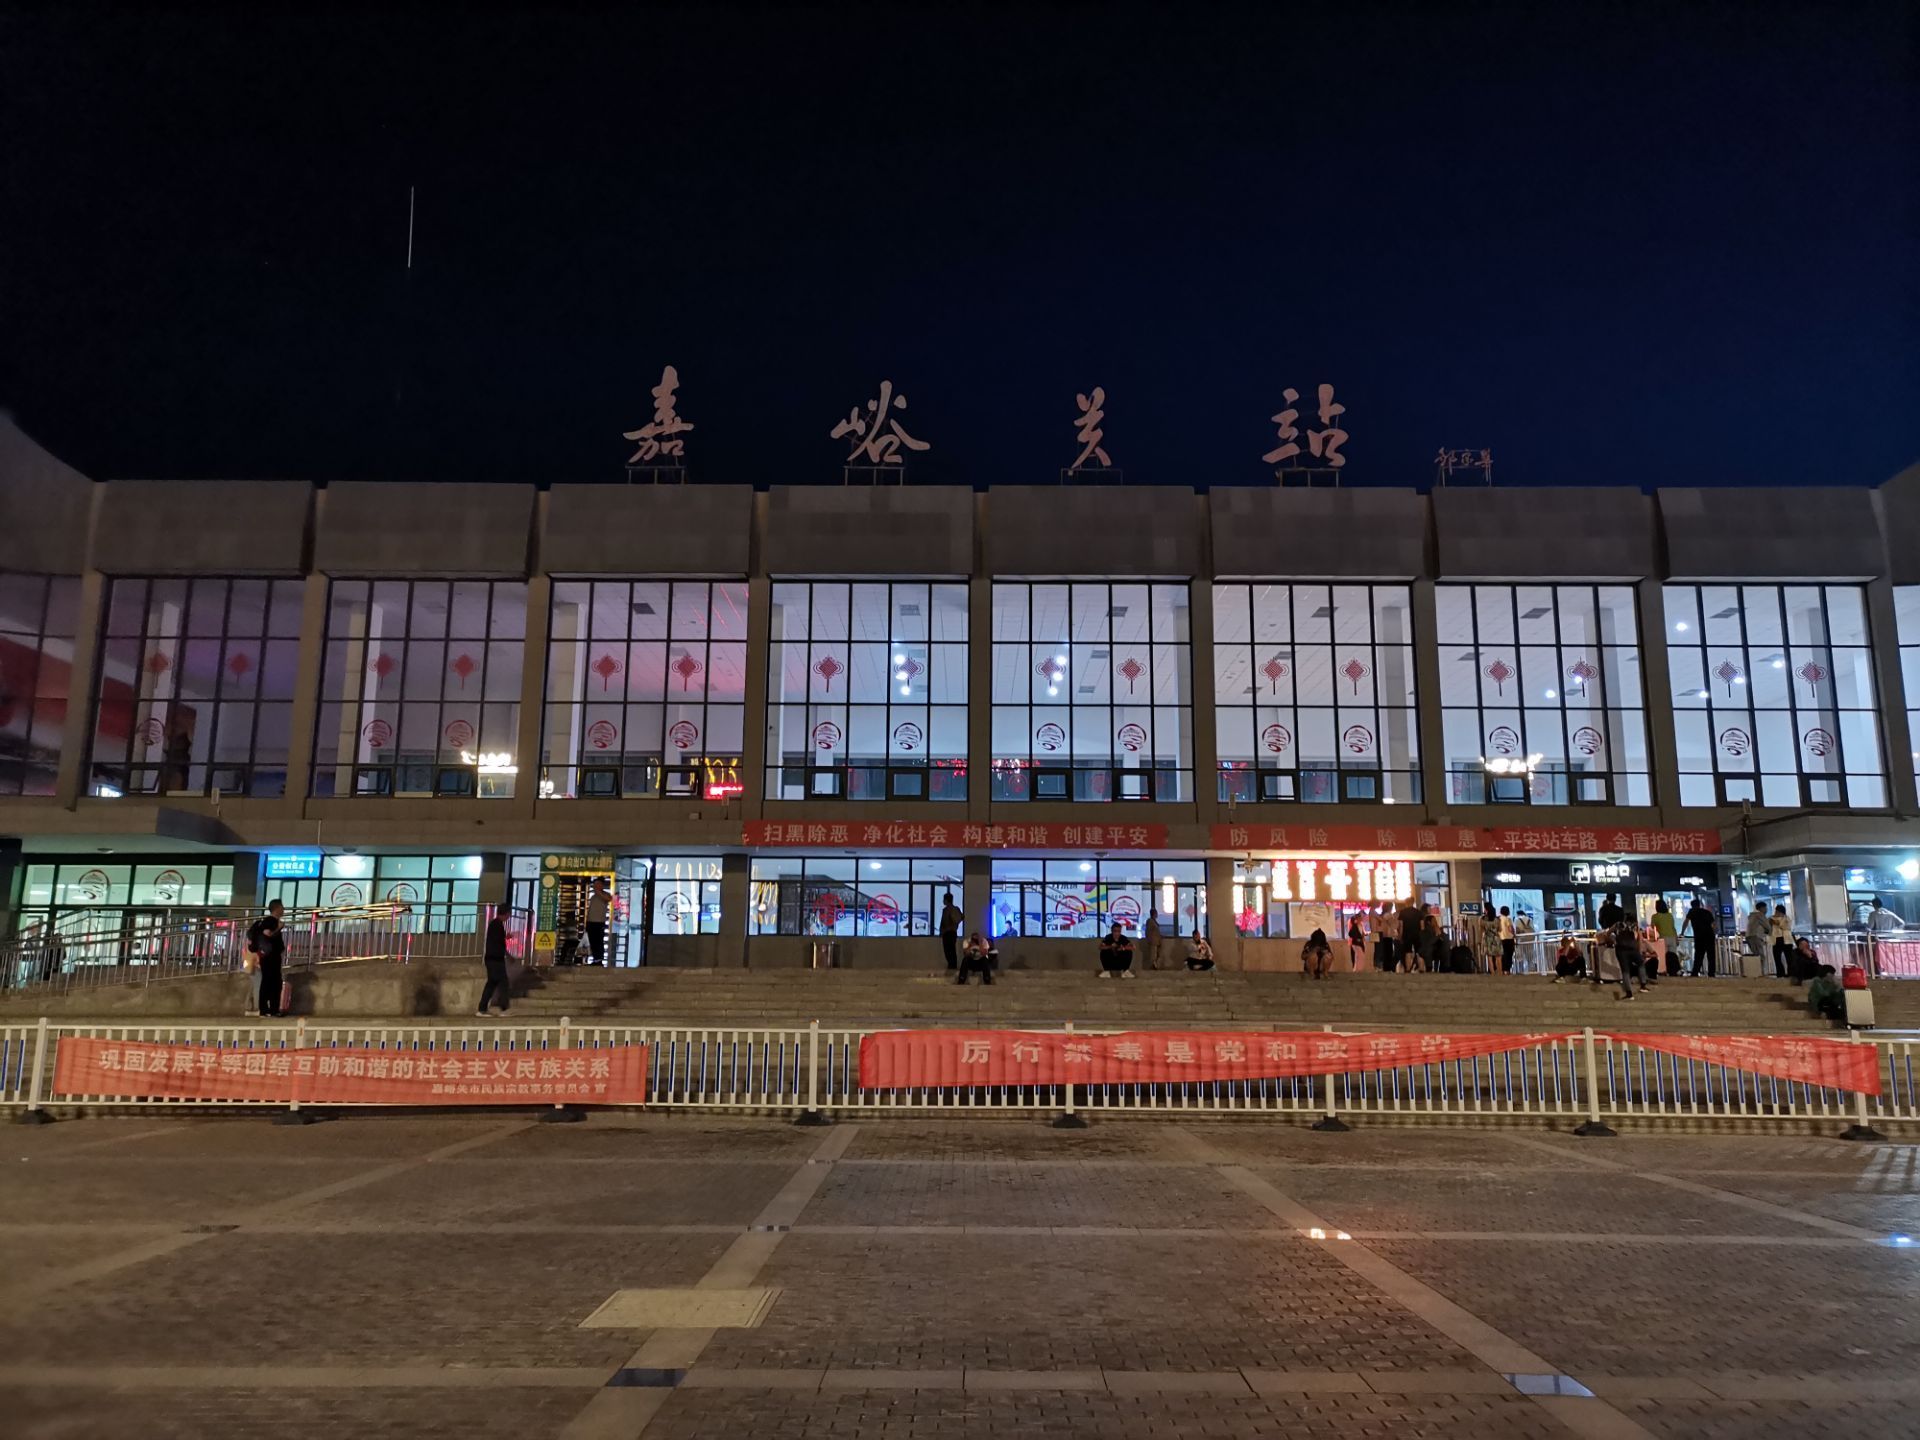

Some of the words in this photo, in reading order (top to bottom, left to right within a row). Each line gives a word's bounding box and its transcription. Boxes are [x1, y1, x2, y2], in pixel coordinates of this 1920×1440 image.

[623, 365, 1349, 468] 嘉峪关站
[764, 824, 849, 843] 扫黑除恶
[863, 825, 947, 844] 净化社会
[962, 825, 1049, 845] 构建和谐
[1063, 826, 1149, 846] 创建平安
[1503, 832, 1598, 850] 平安站车路
[1612, 833, 1706, 852] 金盾护你行
[1462, 903, 1479, 911] 入口
[98, 1049, 611, 1080] 巩固发展平等团结互助和谐的社会主义民族关系
